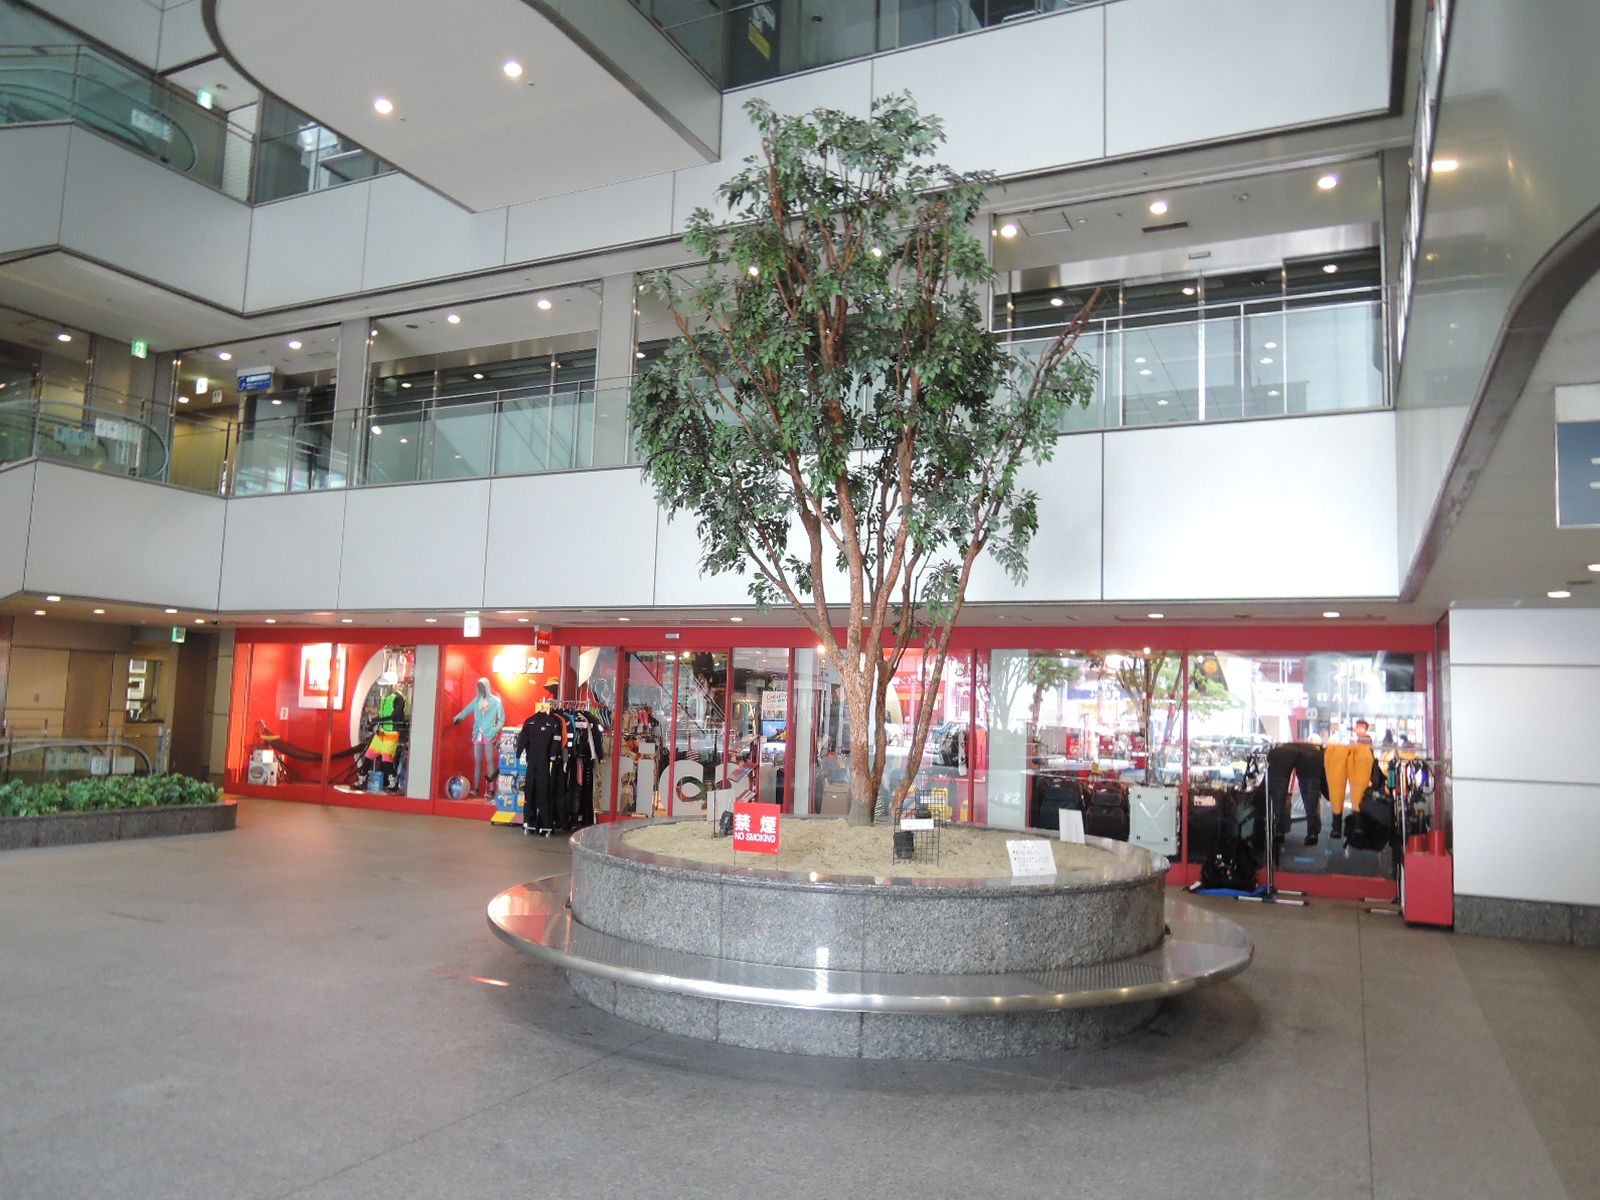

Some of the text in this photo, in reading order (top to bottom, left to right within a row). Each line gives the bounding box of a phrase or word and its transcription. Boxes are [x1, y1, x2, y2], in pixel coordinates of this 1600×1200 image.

[735, 813, 777, 834] 禁煙
[734, 831, 776, 843] NO SMOKING
